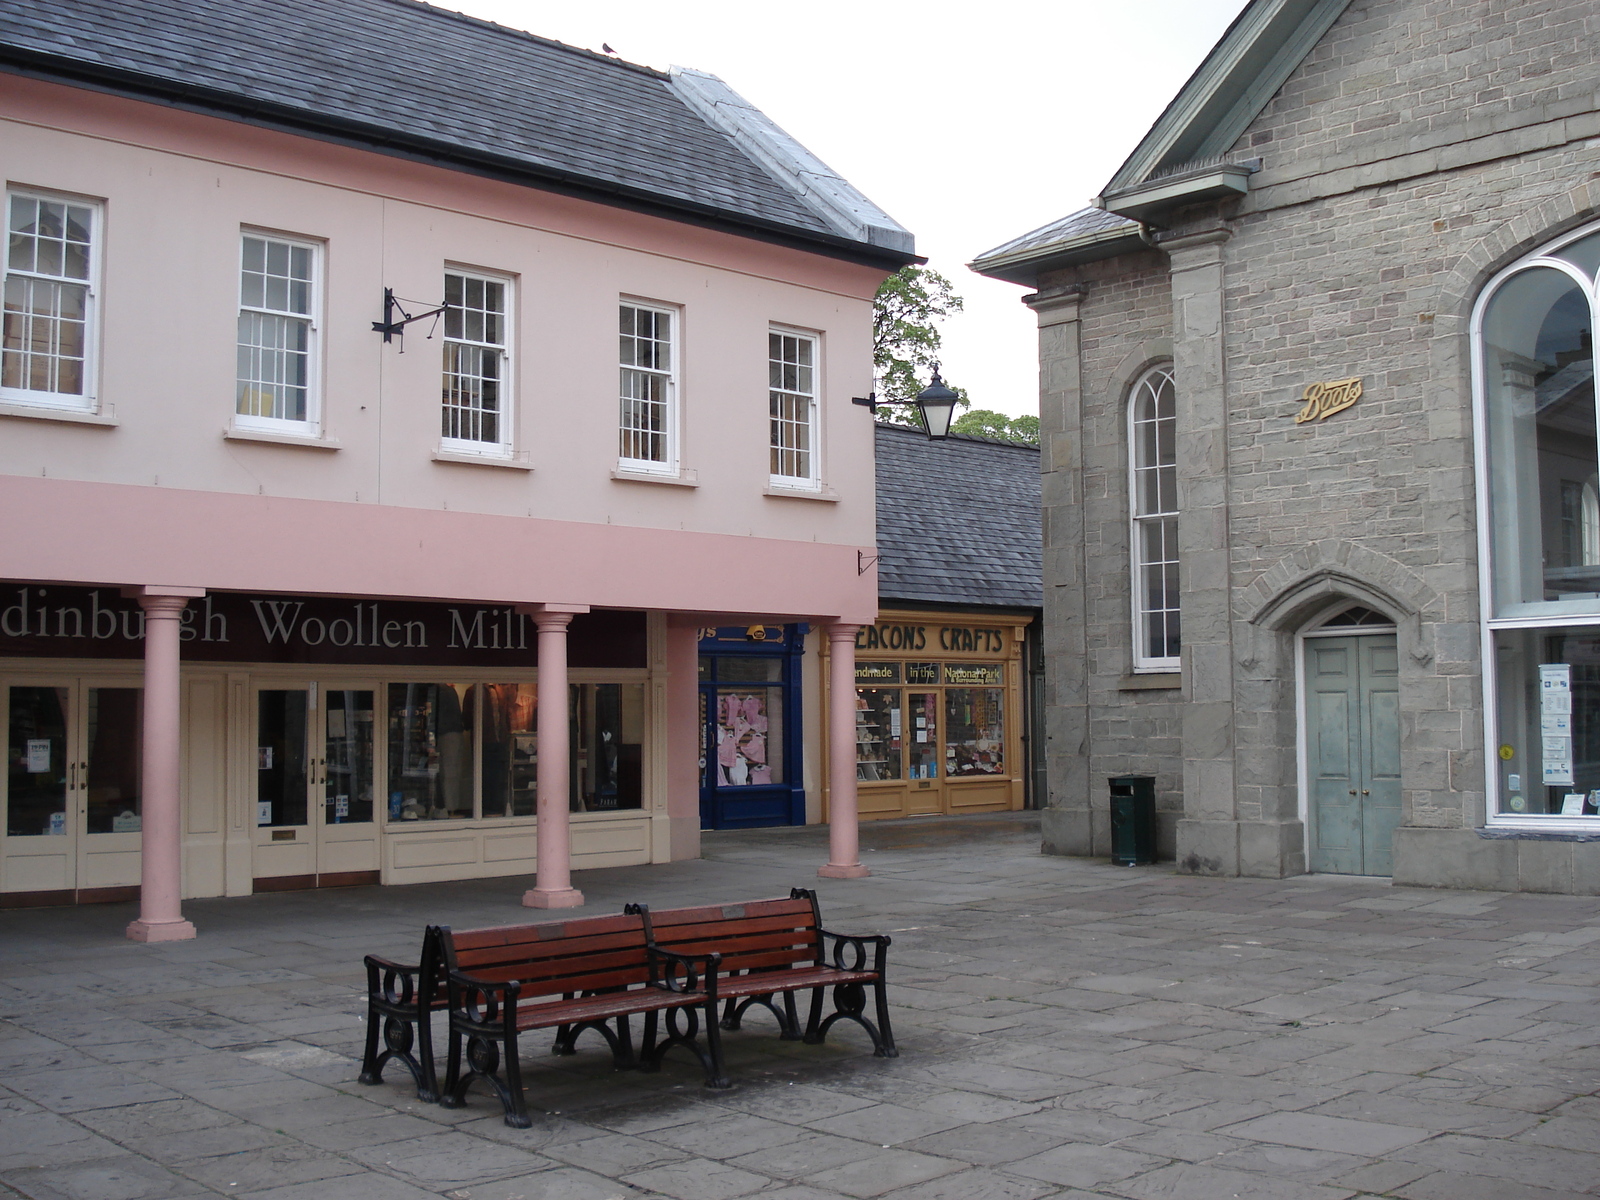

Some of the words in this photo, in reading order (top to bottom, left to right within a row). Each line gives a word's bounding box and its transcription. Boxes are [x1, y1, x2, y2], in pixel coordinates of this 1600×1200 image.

[1294, 377, 1362, 424] Boots
[1, 587, 230, 642] dinbugh
[250, 600, 429, 648] Woollen
[446, 608, 528, 650] Mill
[854, 625, 926, 650] EACONS
[940, 627, 1003, 652] CRAFTS
[945, 667, 979, 678] National
[981, 668, 1000, 678] Park
